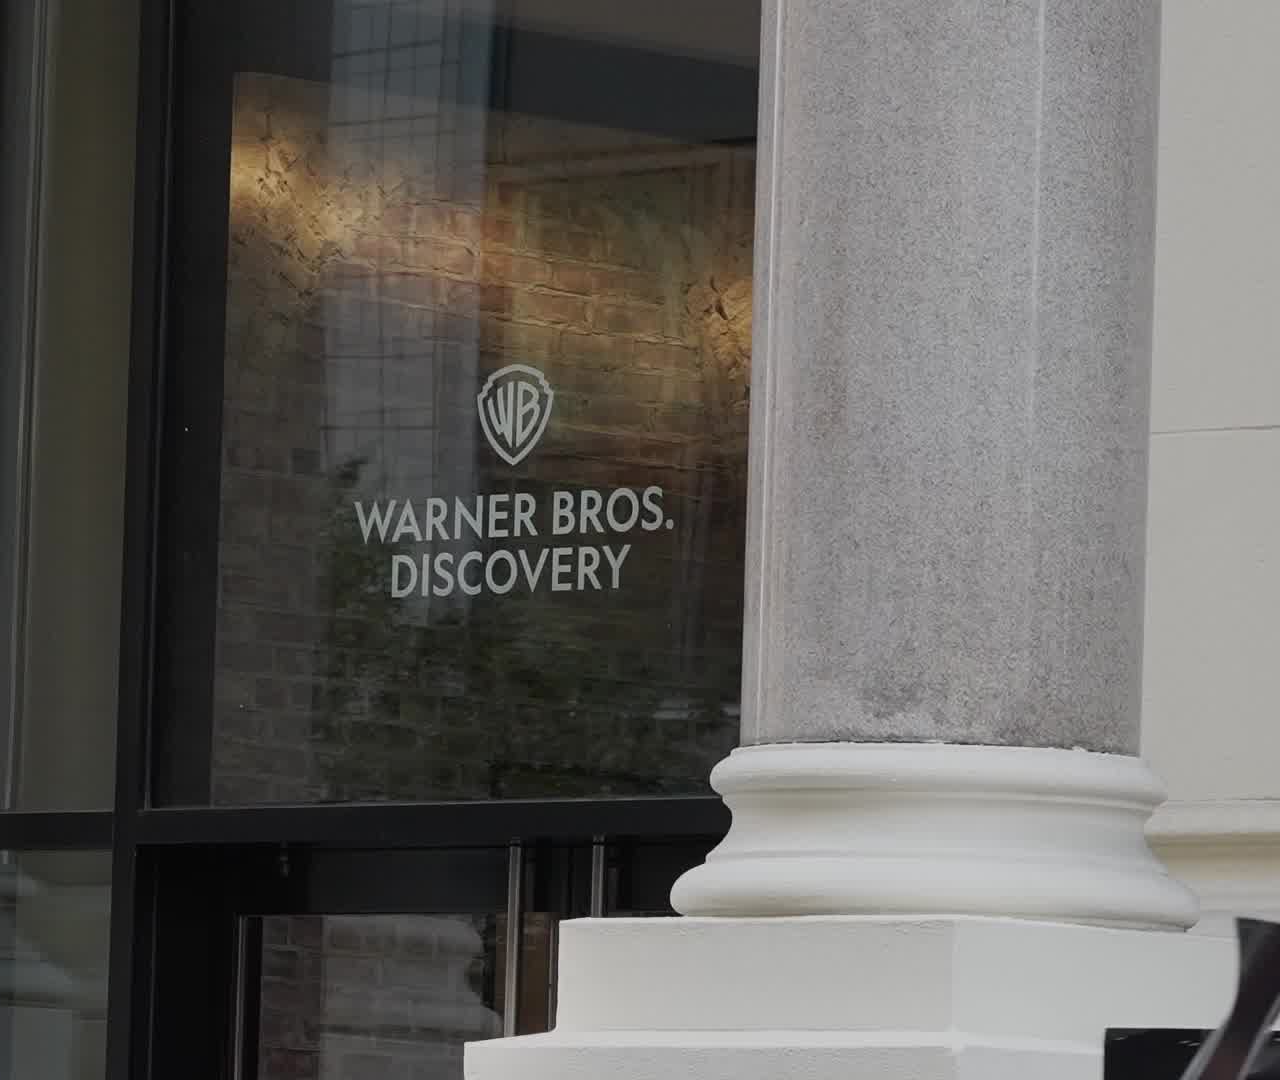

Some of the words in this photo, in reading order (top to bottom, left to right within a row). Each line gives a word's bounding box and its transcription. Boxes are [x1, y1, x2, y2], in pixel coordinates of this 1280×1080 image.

[353, 493, 538, 545] WARNER
[552, 486, 674, 536] BROS.
[391, 544, 632, 598] DISCOVERY
